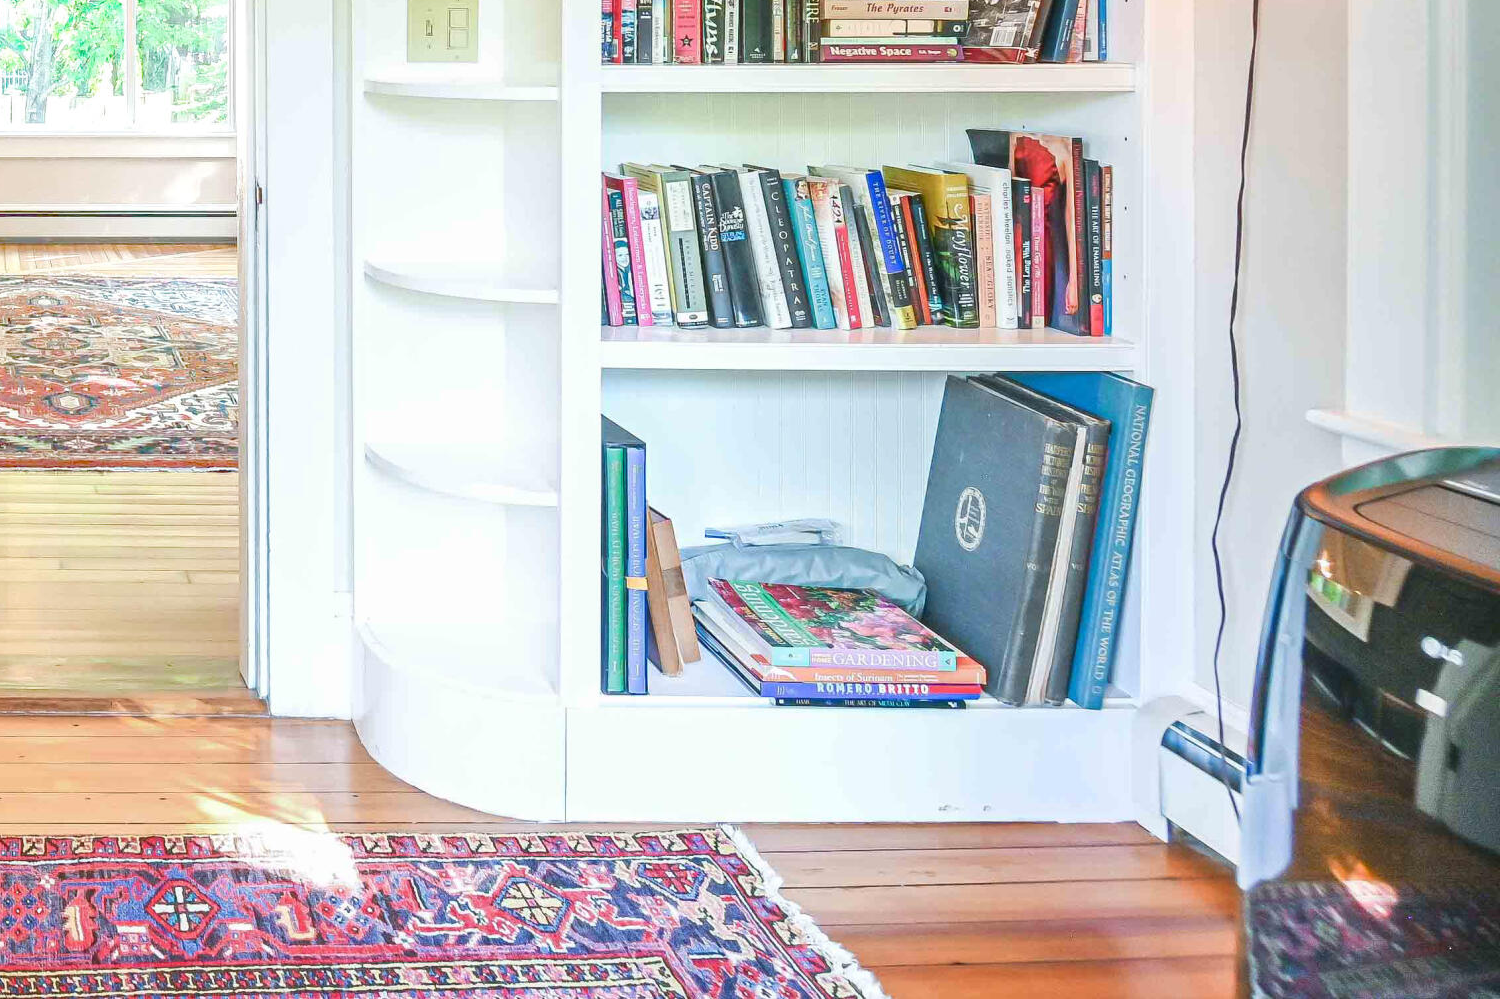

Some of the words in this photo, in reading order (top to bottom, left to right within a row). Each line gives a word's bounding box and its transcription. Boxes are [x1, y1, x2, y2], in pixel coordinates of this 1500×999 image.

[866, 3, 882, 13] The
[887, 3, 924, 13] Pyrates
[830, 47, 877, 55] Negative
[880, 47, 911, 56] Space
[873, 182, 881, 197] THE
[1002, 183, 1011, 210] charles
[702, 183, 715, 225] CAPTAIN
[831, 195, 841, 223] 1421
[877, 201, 887, 224] RIVER
[1091, 206, 1099, 220] THE
[708, 227, 719, 251] KIDD
[884, 227, 890, 236] OF
[1003, 213, 1011, 244] wheelan
[1092, 236, 1099, 245] OF
[627, 187, 637, 224] Bootleggers,
[632, 226, 641, 262] Lobstermen
[637, 271, 646, 309] Lumberjacks
[771, 192, 802, 305] CLEOPATRA
[885, 239, 896, 265] DOUBT
[953, 204, 972, 289] Mayflower
[1005, 249, 1013, 273] naked
[1006, 275, 1014, 307] statistics
[1125, 404, 1147, 467] NATIONAL
[1036, 504, 1061, 515] SPAIN
[1113, 469, 1136, 547] GEOGRAPHIC
[1107, 551, 1124, 587] ATLAS
[1106, 590, 1117, 606] OF
[1101, 611, 1114, 633] THE
[833, 652, 938, 667] GARDENING
[1092, 637, 1110, 681] WORLD
[814, 672, 845, 681] Insects
[846, 672, 855, 681] of
[857, 673, 893, 682] Surinam
[817, 682, 872, 694] ROMERO
[877, 684, 929, 695] BRITTO
